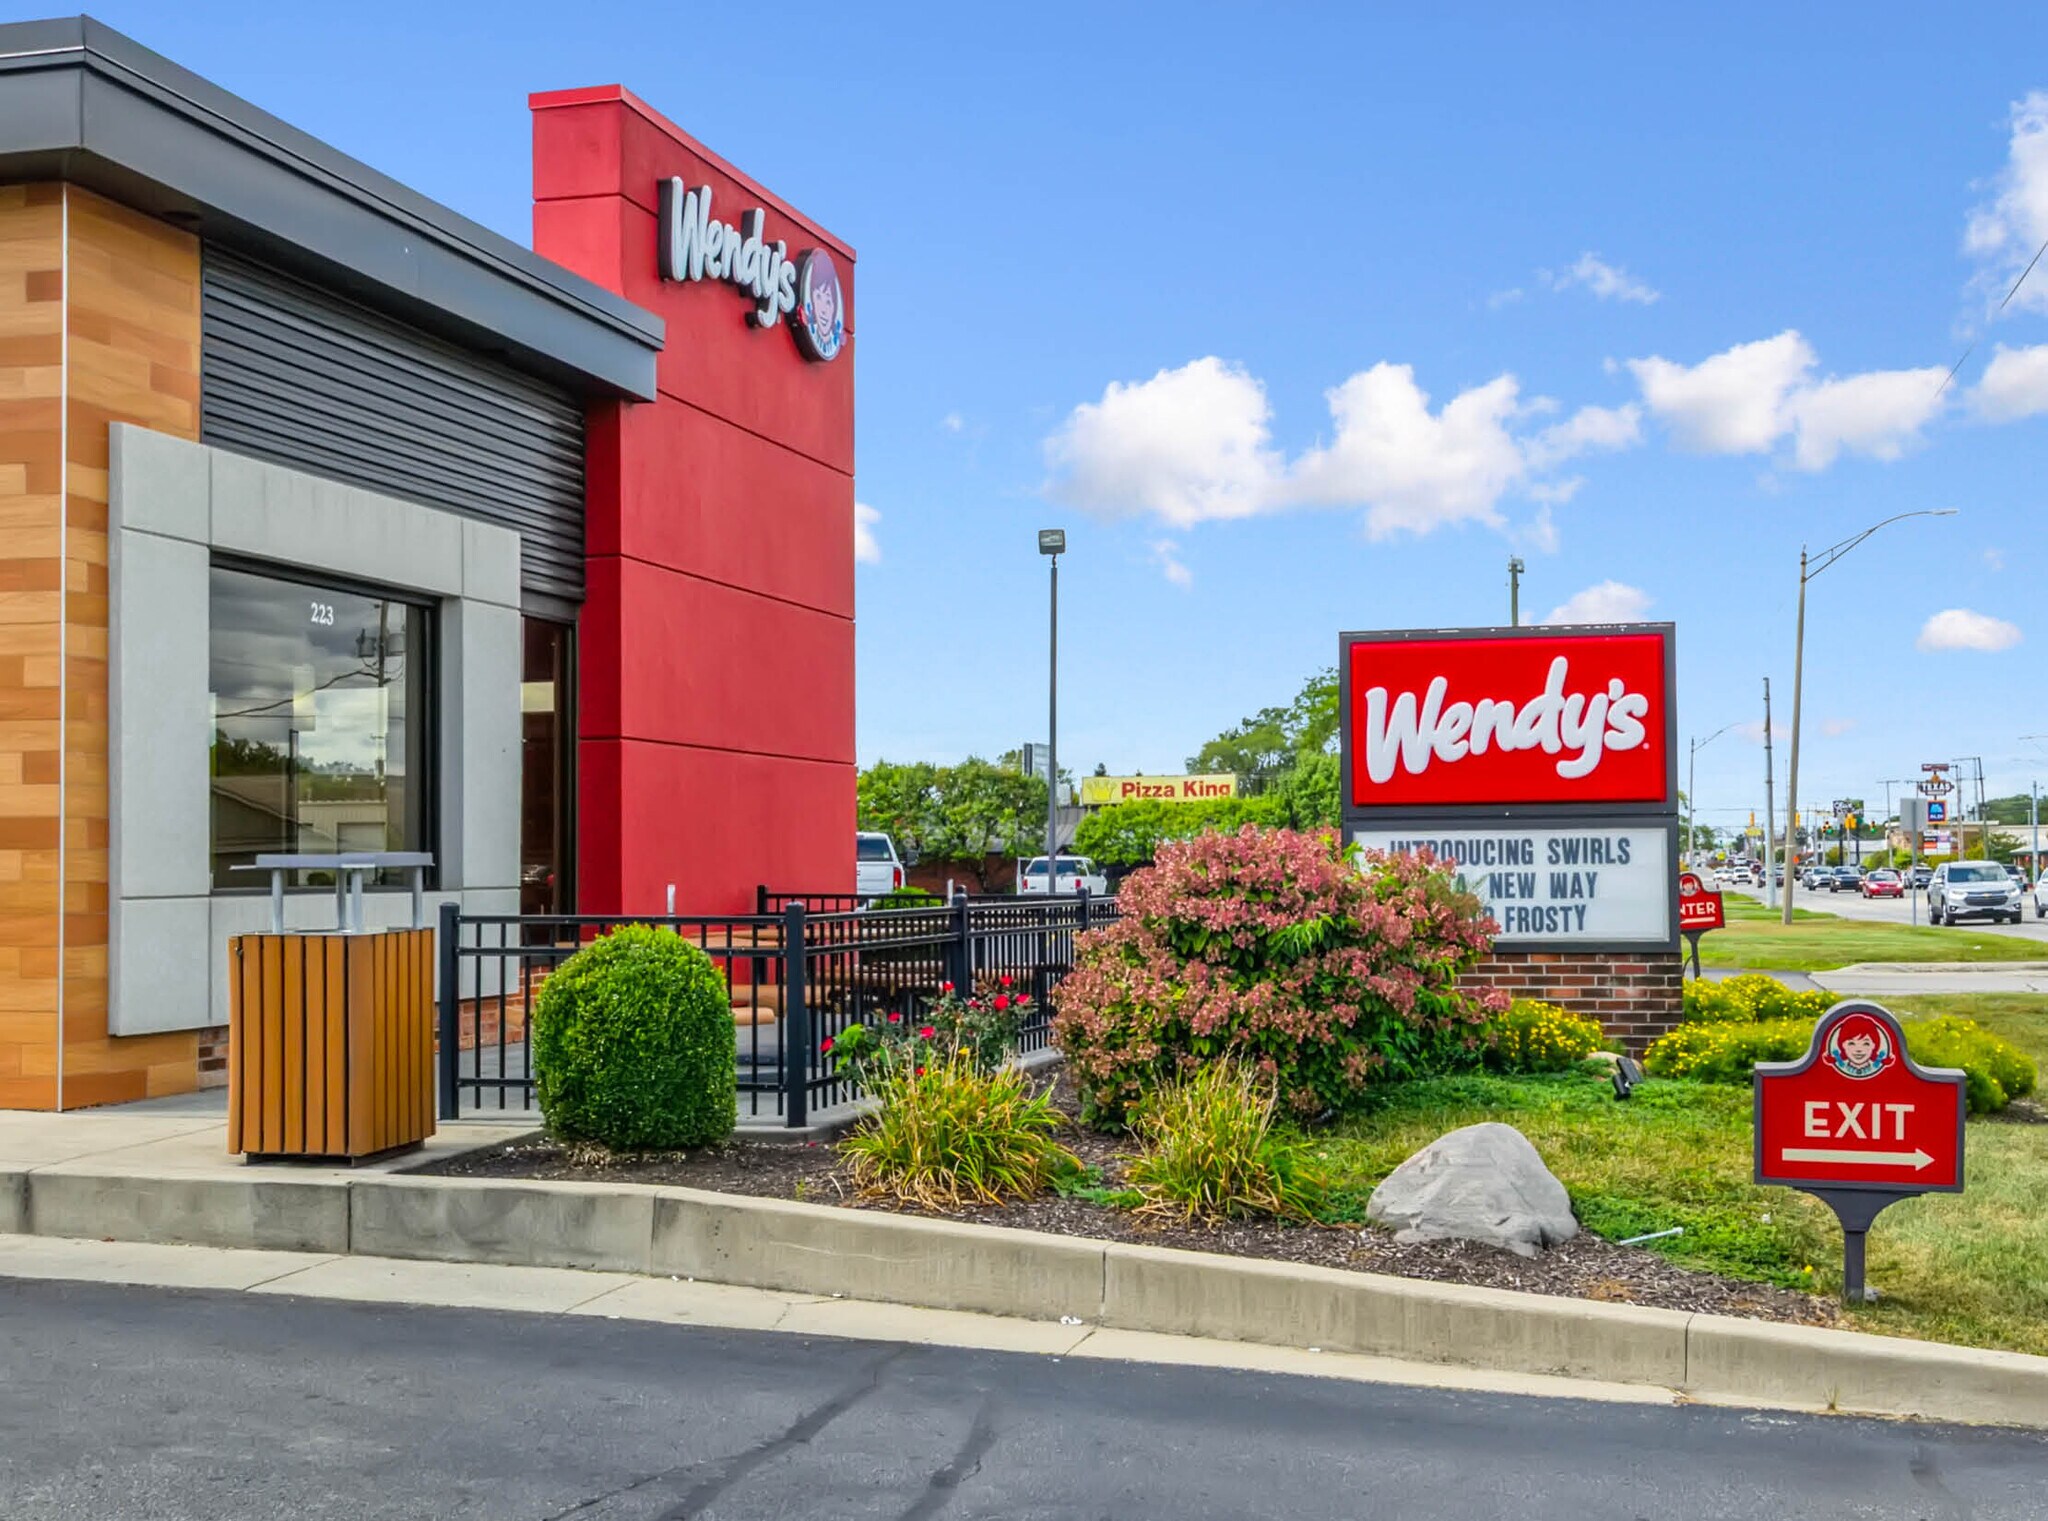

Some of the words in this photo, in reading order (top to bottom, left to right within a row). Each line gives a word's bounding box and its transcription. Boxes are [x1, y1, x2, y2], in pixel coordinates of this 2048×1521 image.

[671, 175, 797, 328] Wendy's
[311, 602, 334, 626] 223
[1365, 655, 1649, 784] Wendy's
[1121, 782, 1175, 798] Pizza
[1547, 837, 1631, 865] SWIRLS
[1489, 872, 1536, 898] NEW
[1549, 871, 1598, 899] WAY
[1505, 904, 1587, 933] FROSTY
[1680, 901, 1716, 916] NTER
[1804, 1101, 1915, 1141] EXIT
